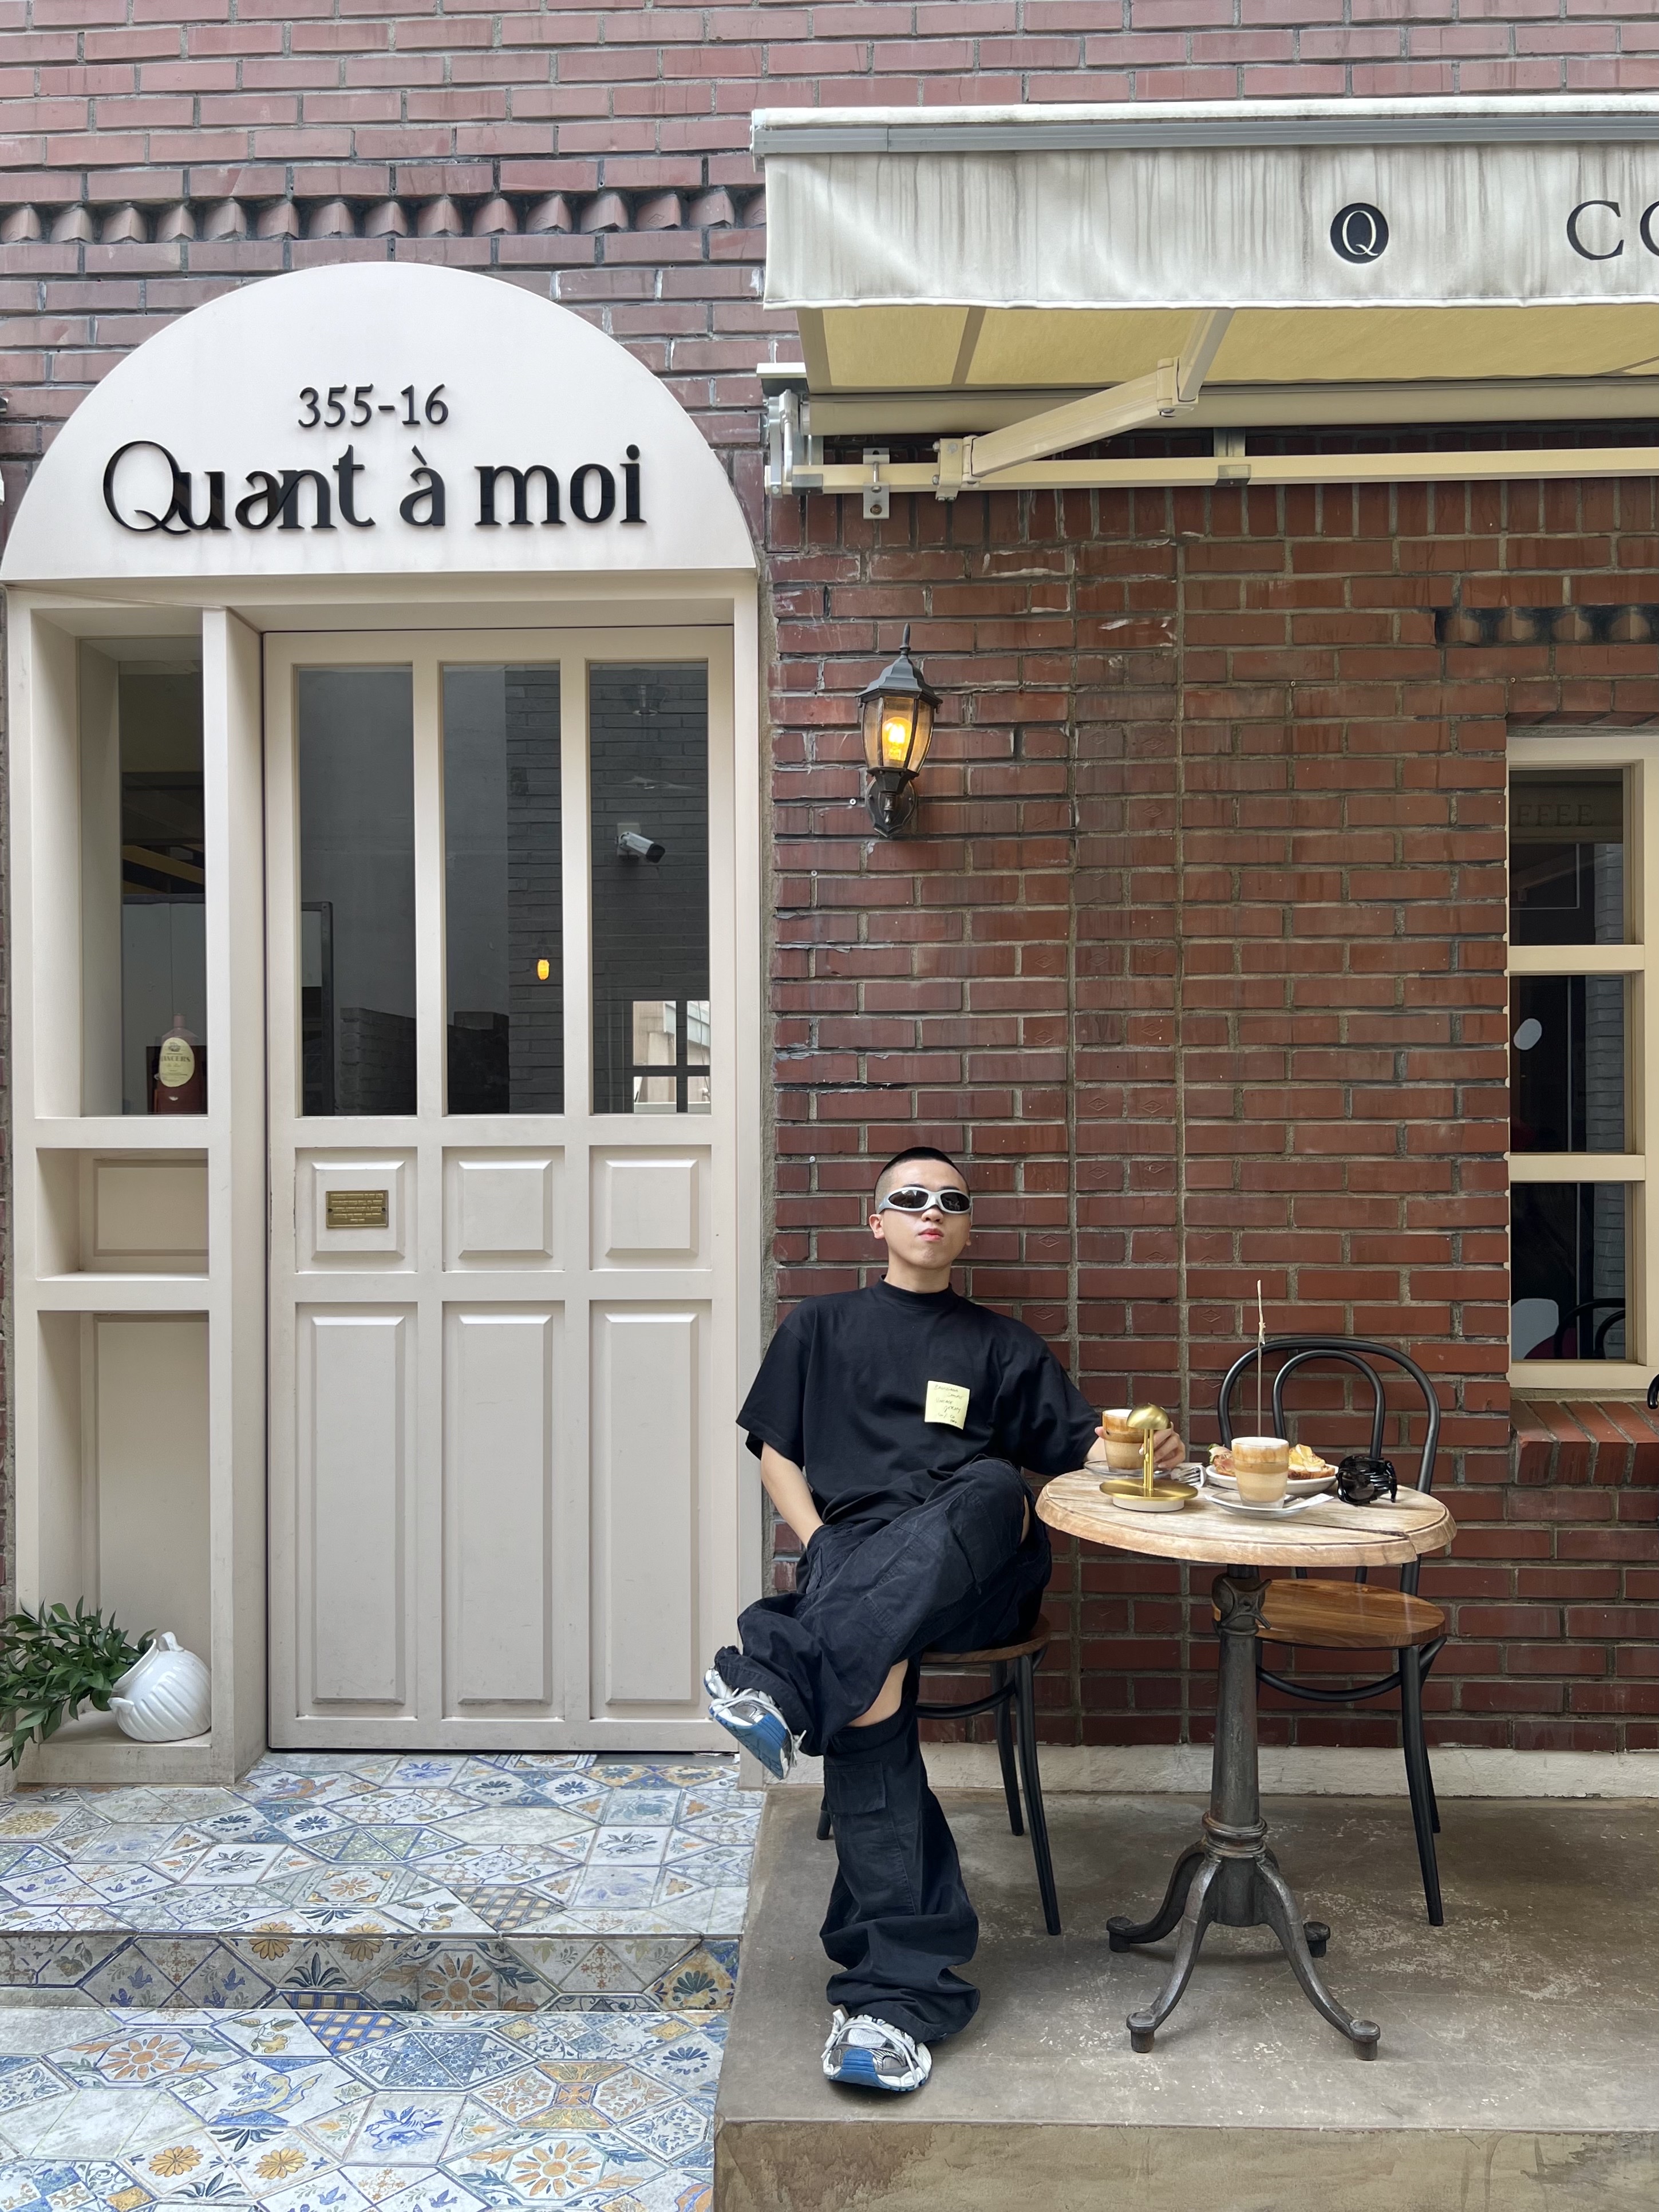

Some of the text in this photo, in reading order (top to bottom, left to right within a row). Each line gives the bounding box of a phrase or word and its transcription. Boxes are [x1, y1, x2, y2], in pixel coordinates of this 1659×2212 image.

[1342, 210, 1378, 256] Q
[298, 383, 449, 428] 355-16
[102, 440, 647, 535] Quant à moi
